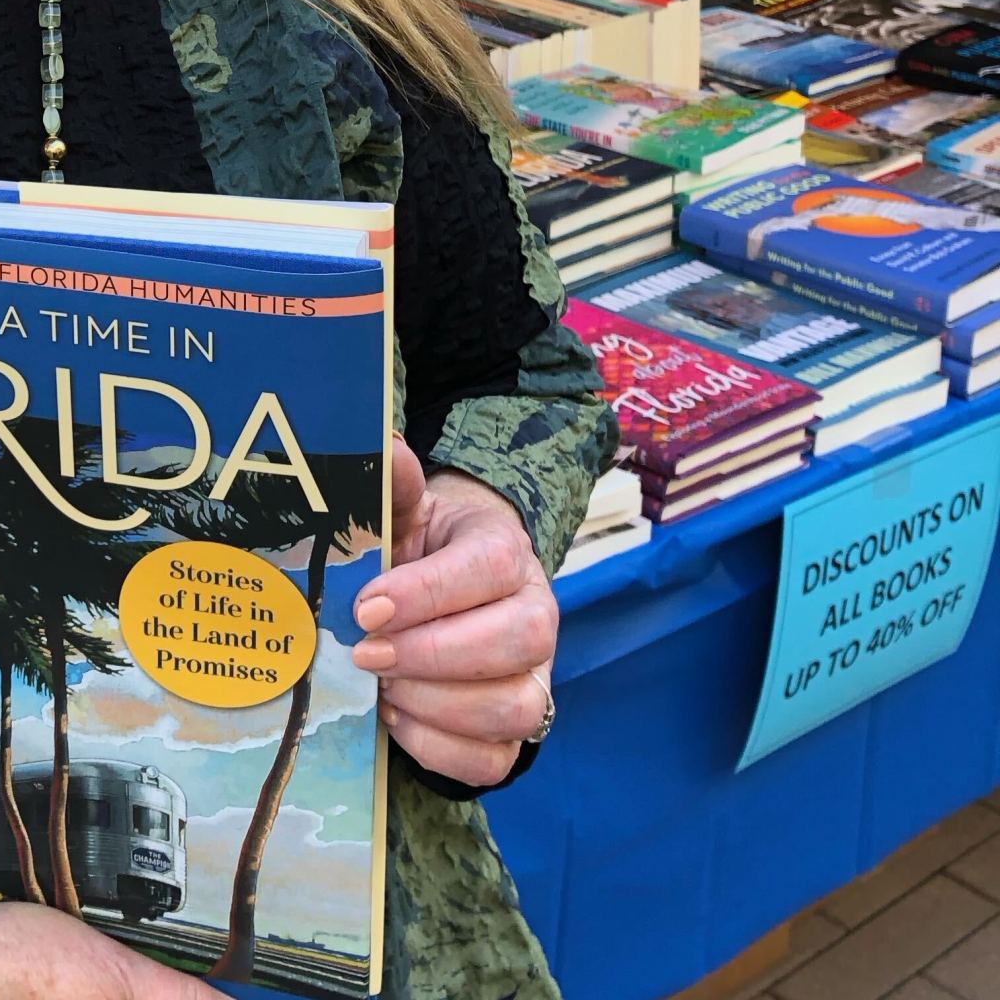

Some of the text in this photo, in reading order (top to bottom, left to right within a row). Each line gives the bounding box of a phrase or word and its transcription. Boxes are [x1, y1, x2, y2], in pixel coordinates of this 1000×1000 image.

[542, 118, 568, 137] STATE
[602, 134, 613, 148] IN
[0, 263, 119, 295] FLORIDA
[130, 279, 317, 317] HUMANITIES
[767, 250, 895, 300] Writing for the Public Good
[792, 283, 827, 305] Writing
[827, 295, 842, 308] for
[842, 299, 858, 313] the
[858, 303, 889, 324] Public
[39, 309, 151, 356] TIME
[168, 326, 215, 363] IN
[632, 345, 704, 381] about
[610, 362, 762, 426] Florida
[802, 483, 985, 596] DISCOUNTS ON
[169, 559, 264, 593] Stories
[819, 546, 953, 637] ALL BOOKS
[159, 589, 276, 624] of Life in
[142, 615, 295, 655] the Land of
[783, 584, 967, 700] UP TO 40% OFF
[156, 648, 279, 685] Promises
